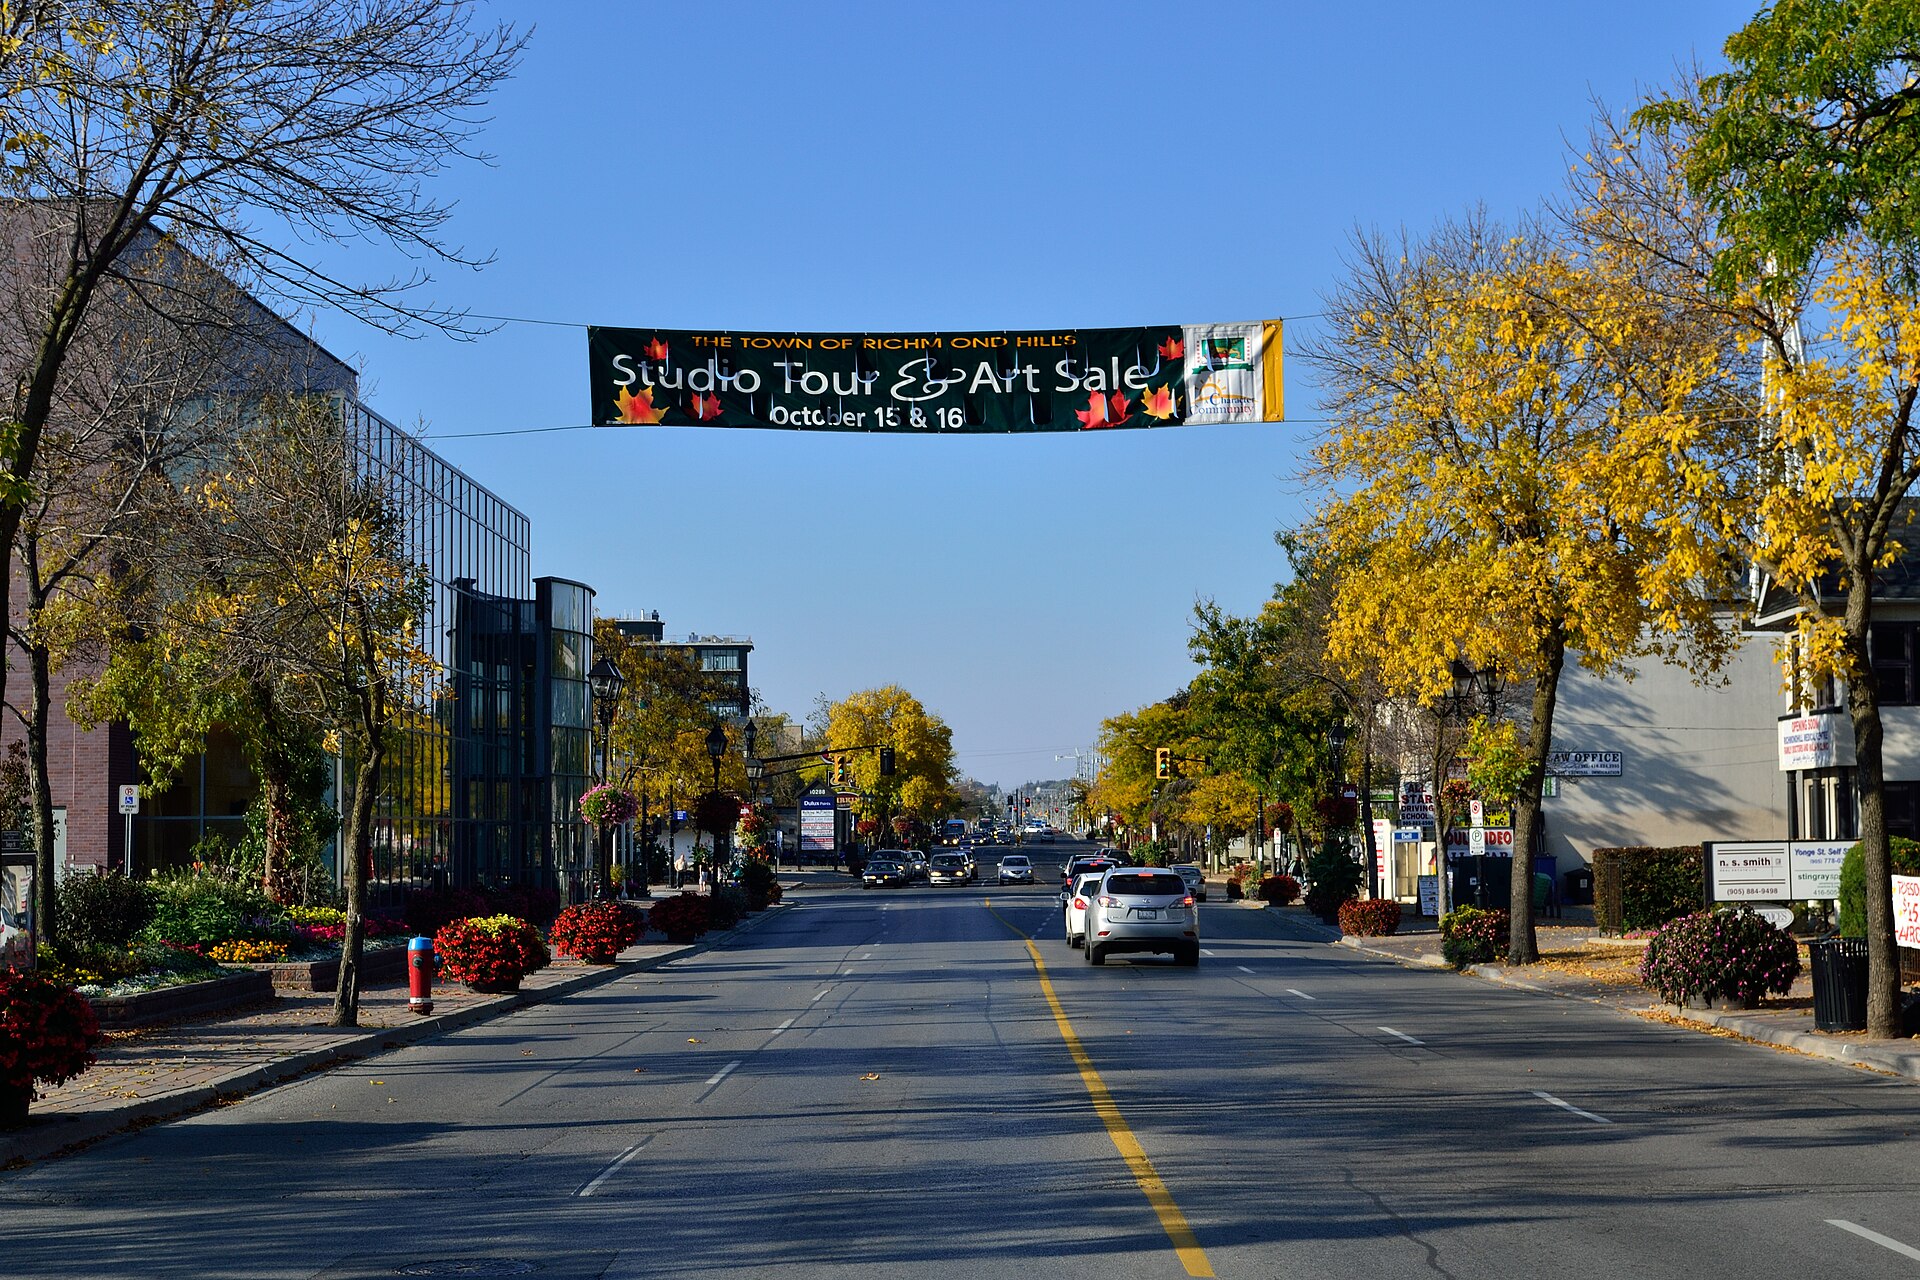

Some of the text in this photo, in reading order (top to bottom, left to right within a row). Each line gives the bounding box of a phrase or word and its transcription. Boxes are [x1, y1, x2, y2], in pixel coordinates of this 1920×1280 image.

[692, 336, 732, 348] THE
[740, 337, 812, 349] TOWN
[819, 338, 853, 350] OF
[1016, 335, 1077, 348] HILL'S
[611, 353, 762, 394] Studio
[772, 361, 881, 396] Tour
[968, 361, 1040, 394] Art
[1055, 356, 1149, 393] Sale
[769, 405, 963, 429] October 15 & 16
[1574, 753, 1620, 763] OFFICE
[1401, 794, 1433, 805] STAR
[1401, 804, 1434, 812] DRIVING
[1401, 812, 1429, 820] SCHOOL
[1484, 830, 1513, 846] IDEO
[1794, 848, 1815, 857] Yonge
[1743, 857, 1771, 867] smith
[1727, 887, 1778, 896] (905) 884-9498
